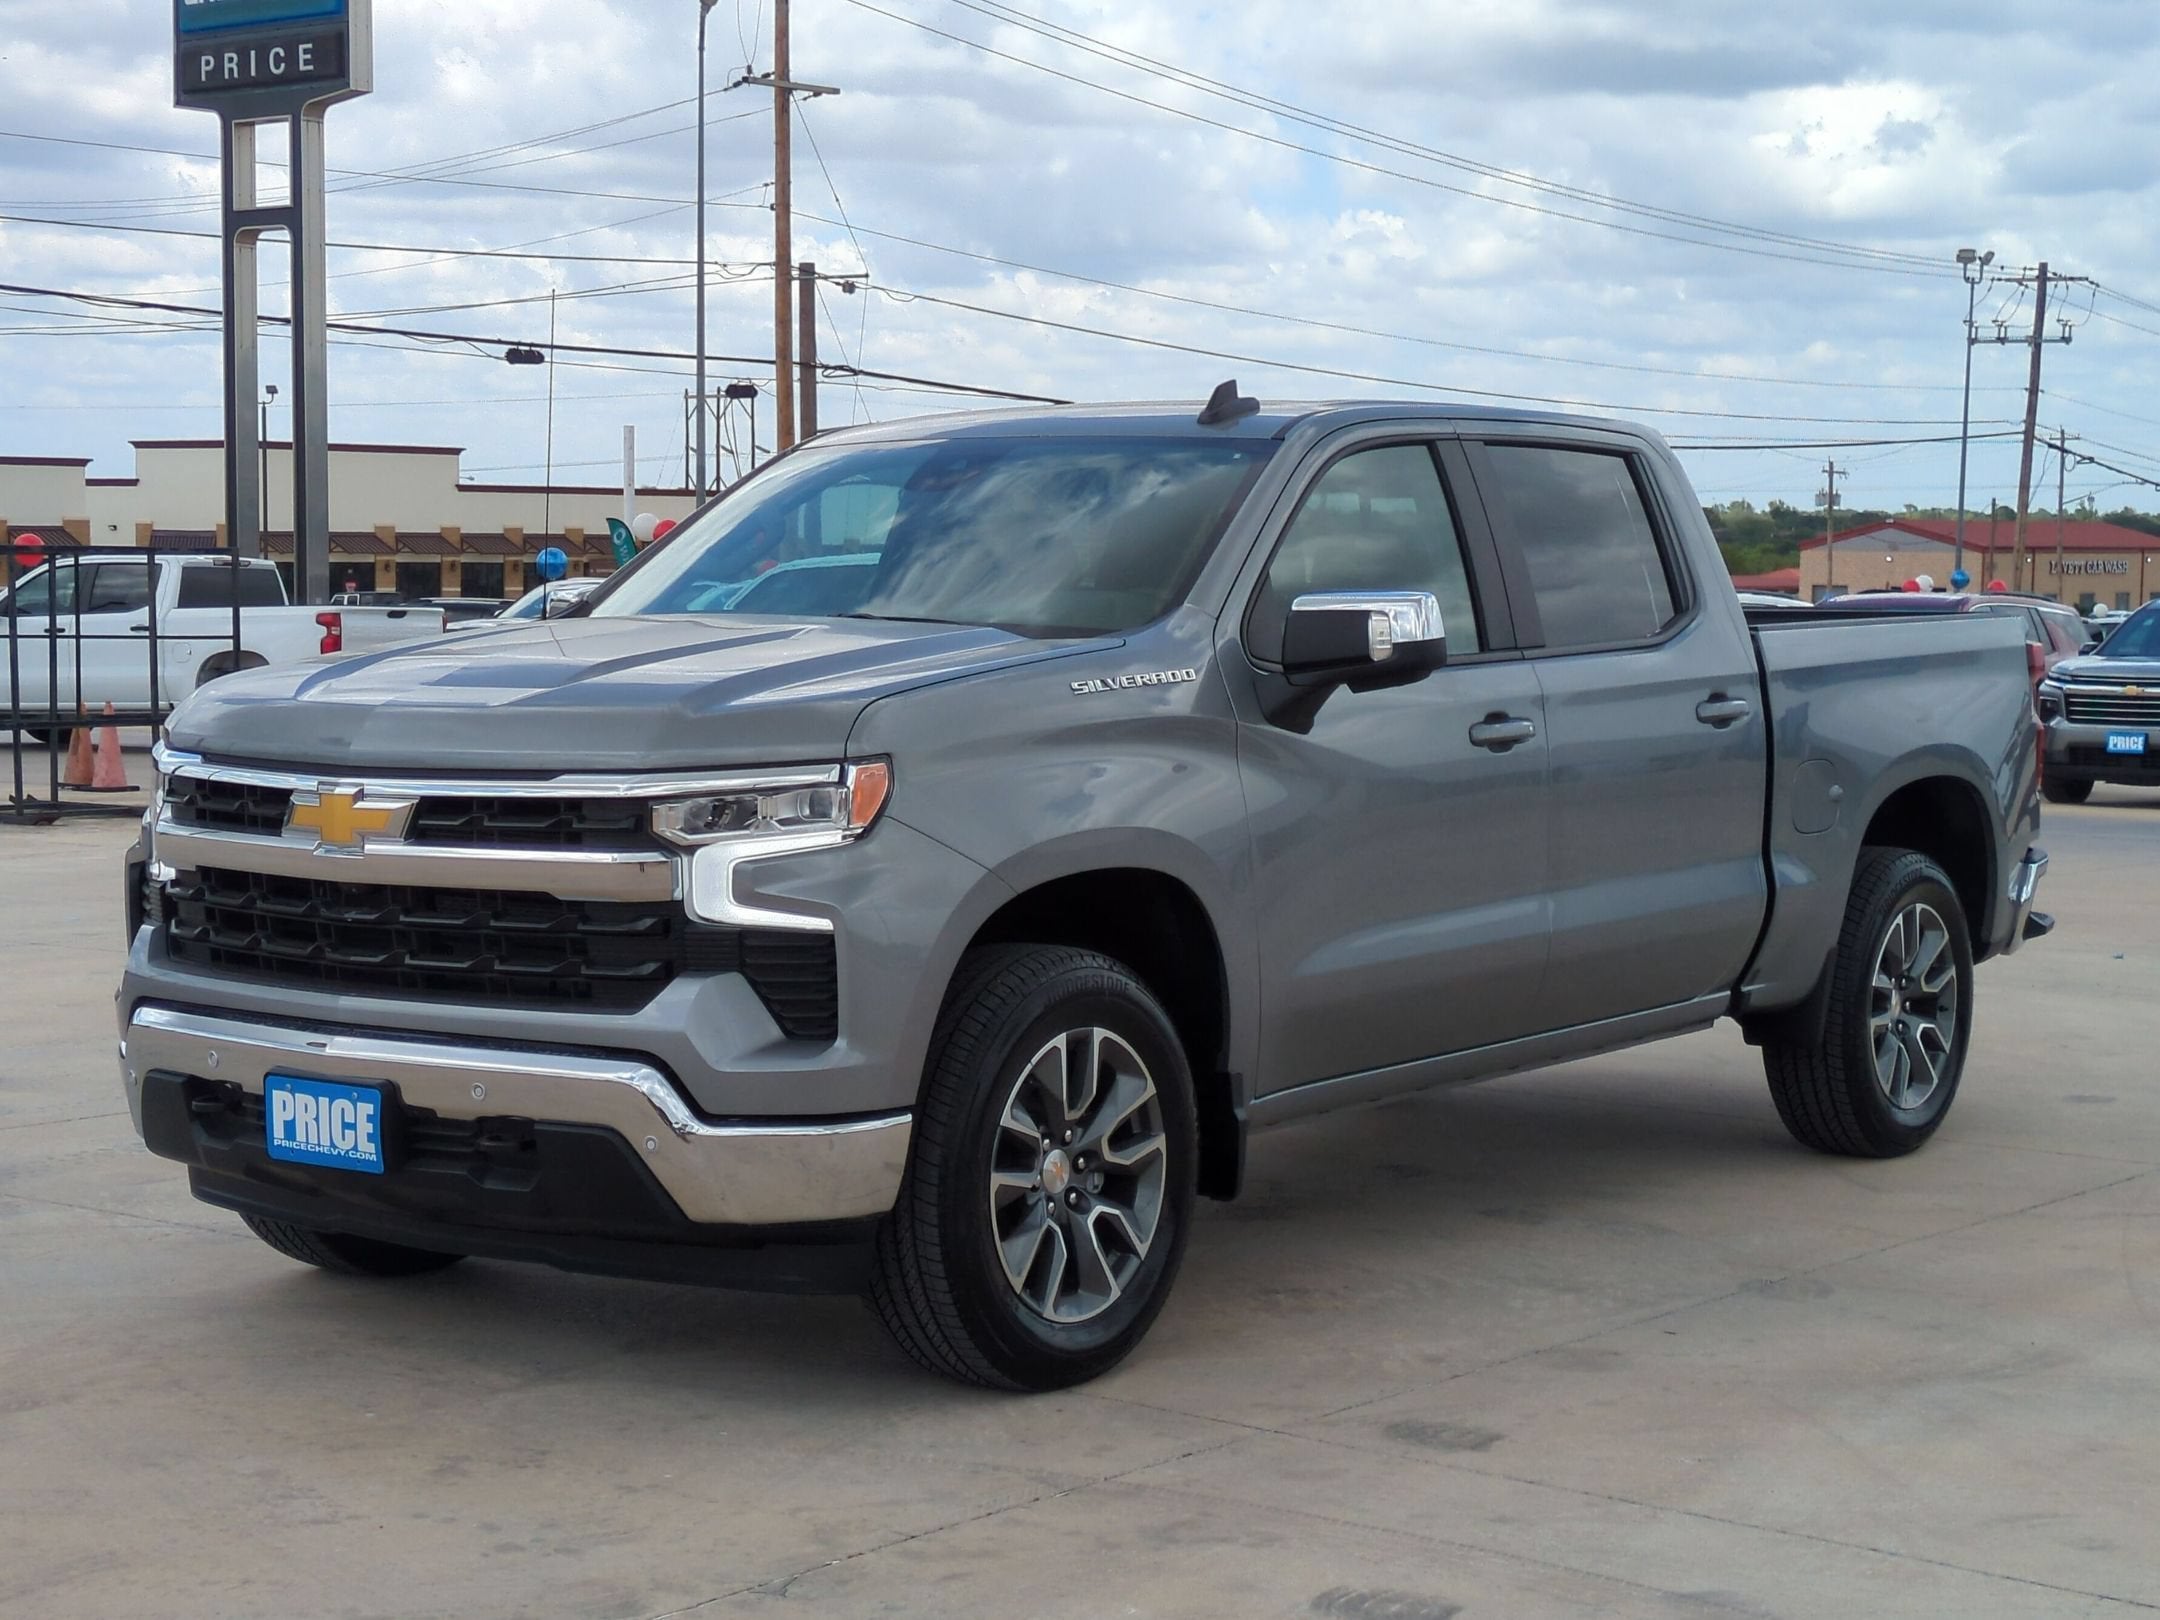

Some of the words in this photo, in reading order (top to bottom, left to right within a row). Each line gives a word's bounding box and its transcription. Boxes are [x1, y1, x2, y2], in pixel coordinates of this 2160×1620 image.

[201, 43, 314, 81] PRICE
[2049, 560, 2083, 574] LVETT
[2086, 560, 2103, 574] CAR
[2104, 560, 2129, 574] WASH
[1071, 668, 1197, 695] SILVERADO
[2108, 735, 2144, 750] PRICE
[272, 1089, 376, 1153] PRICE
[273, 1138, 377, 1162] PRICECHEVY.COM
